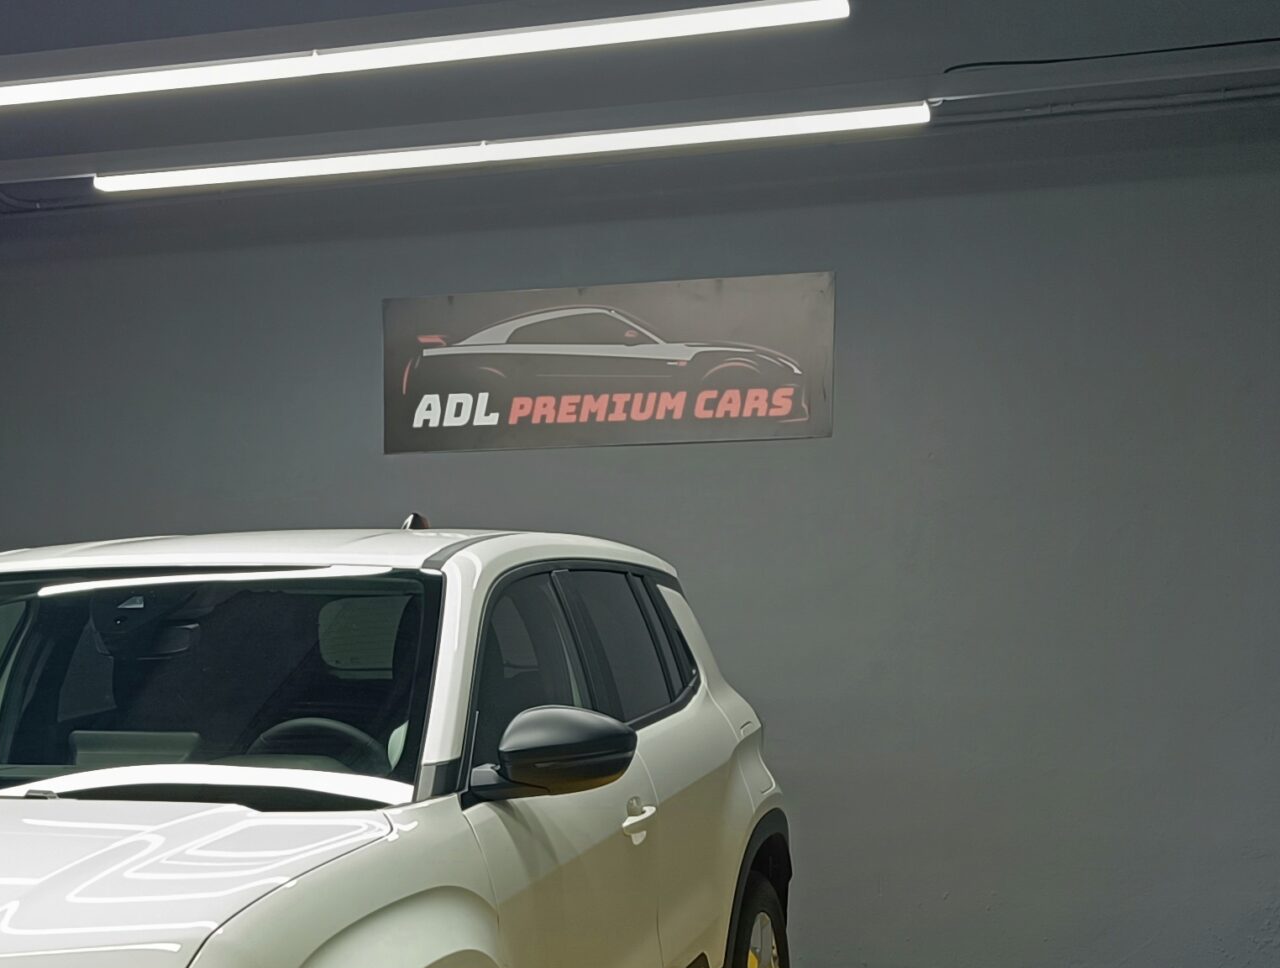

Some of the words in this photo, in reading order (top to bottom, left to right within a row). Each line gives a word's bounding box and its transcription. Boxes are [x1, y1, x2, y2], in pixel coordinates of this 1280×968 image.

[412, 392, 499, 428] ADL
[508, 391, 687, 425] PREMIUM
[694, 387, 794, 418] CARS
